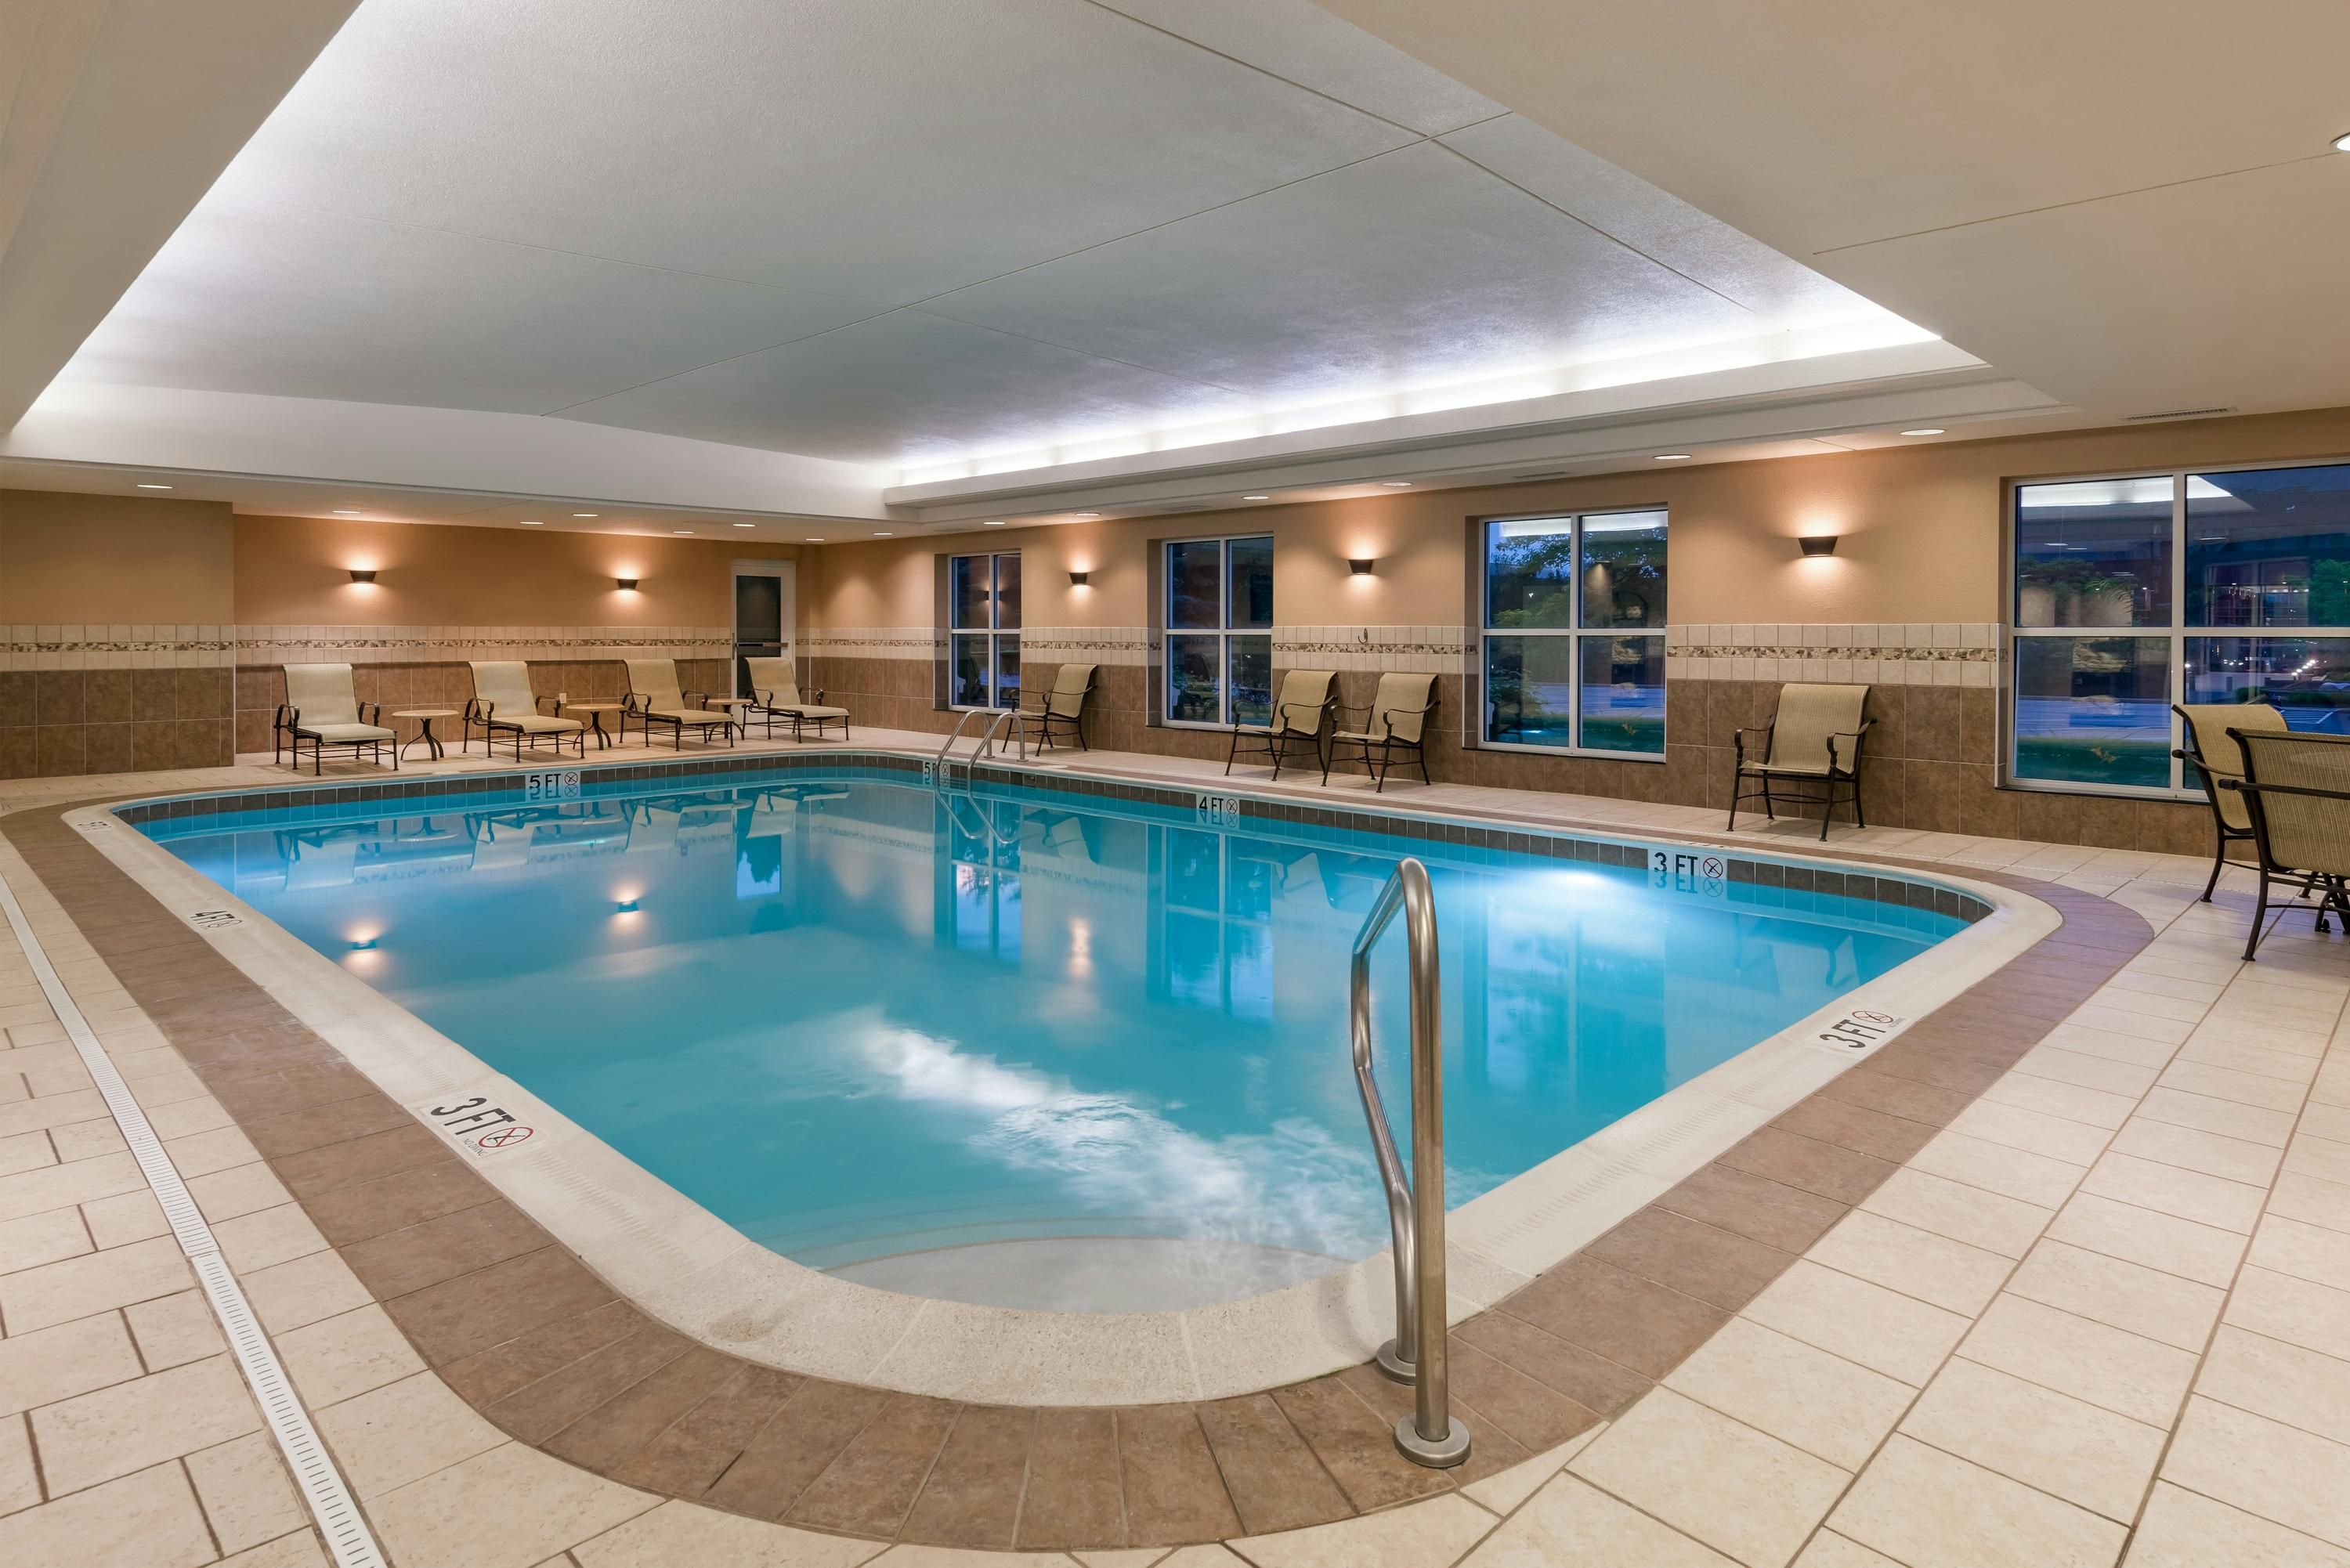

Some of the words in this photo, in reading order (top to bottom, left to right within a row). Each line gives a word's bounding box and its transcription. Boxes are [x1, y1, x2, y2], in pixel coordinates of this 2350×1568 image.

[924, 762, 930, 774] 5
[530, 775, 540, 789] 5
[545, 774, 561, 787] FT
[1199, 797, 1207, 810] 4
[1212, 797, 1224, 812] FT
[1654, 852, 1667, 872] 3
[1676, 854, 1698, 876] FT
[1831, 1019, 1886, 1039] FT
[1819, 1034, 1866, 1048] 3
[431, 1097, 487, 1116] 3
[444, 1107, 516, 1135] FT
